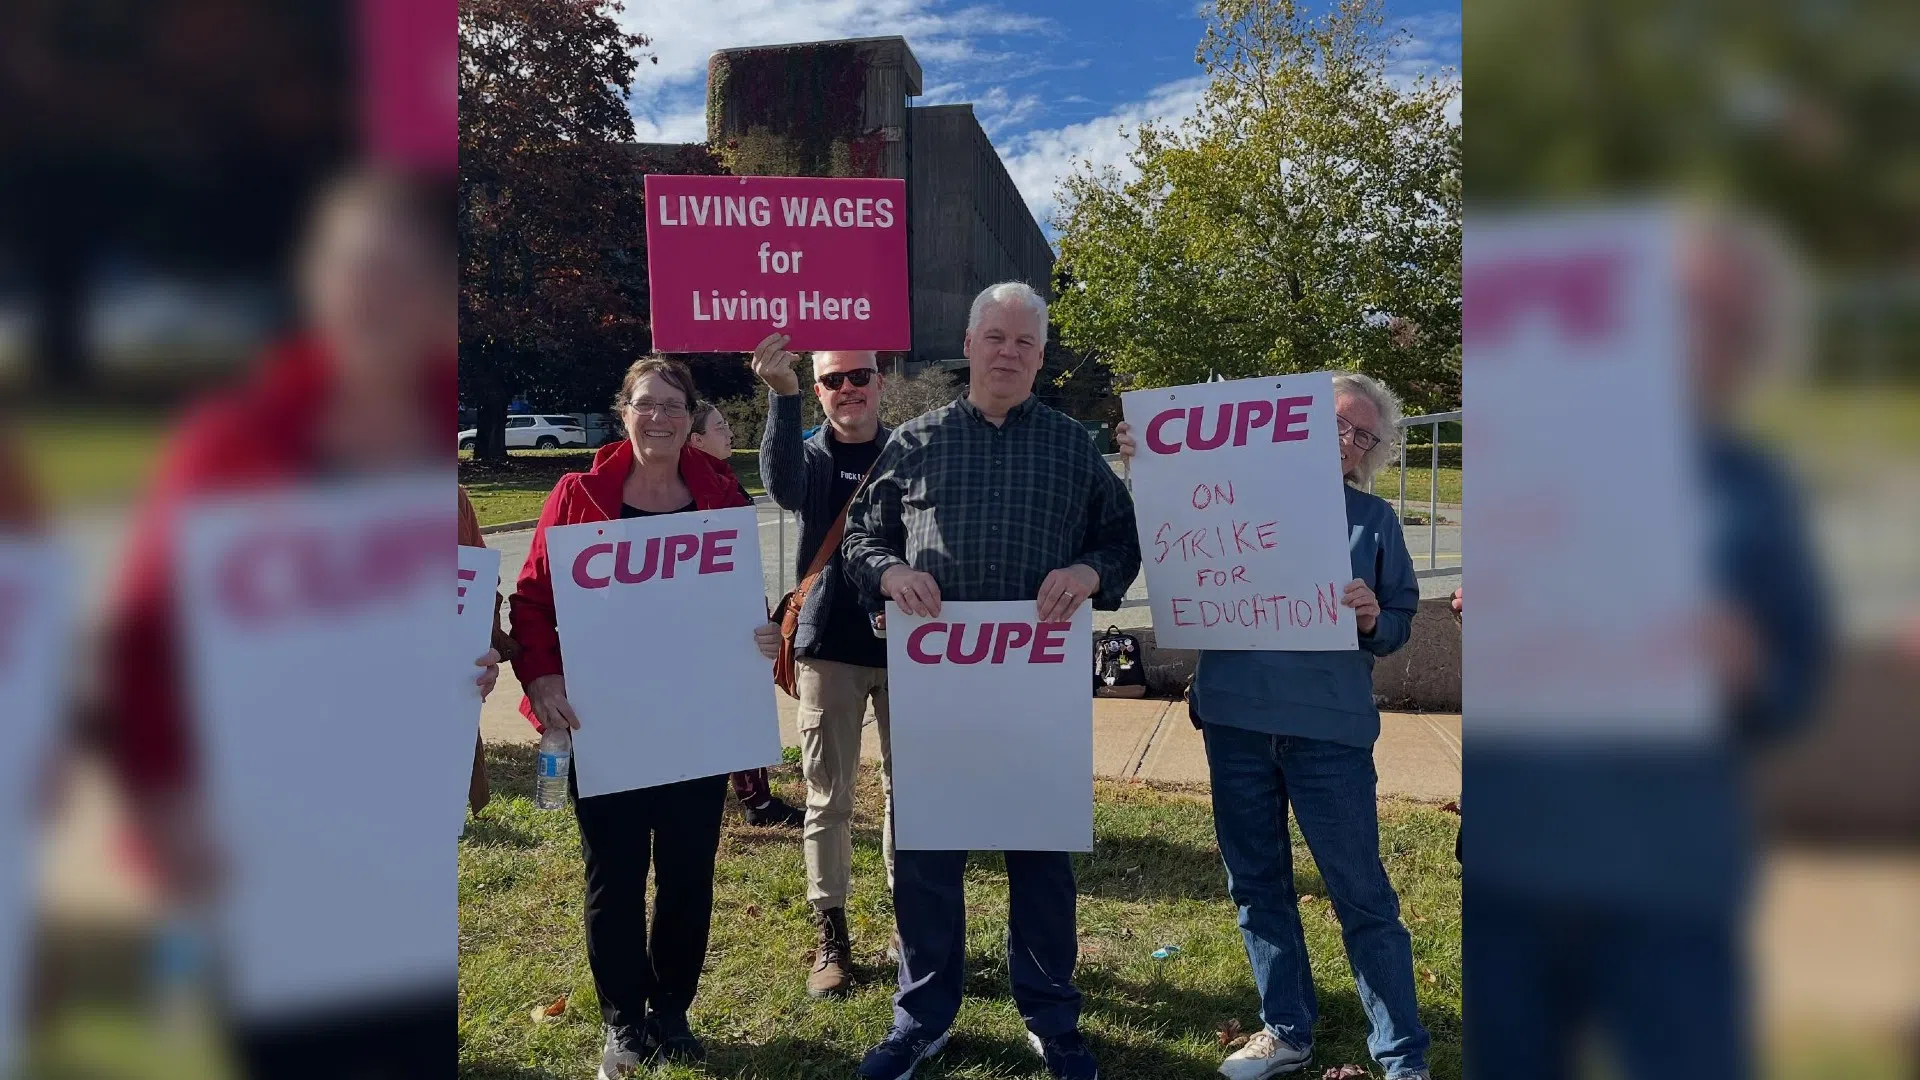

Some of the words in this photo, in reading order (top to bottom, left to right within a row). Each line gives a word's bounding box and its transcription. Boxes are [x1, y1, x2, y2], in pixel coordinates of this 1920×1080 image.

[659, 195, 771, 227] LIVING
[780, 195, 894, 229] WAGES
[757, 241, 803, 274] for
[692, 289, 788, 329] Living
[798, 290, 871, 321] Here
[1145, 395, 1313, 456] CUPE
[1191, 480, 1235, 510] ON
[571, 529, 738, 590] CUPE
[1153, 520, 1280, 564] STRIKE
[1196, 565, 1252, 588] FOR
[1170, 582, 1339, 631] EDUCATION
[906, 621, 1073, 665] CUPE
